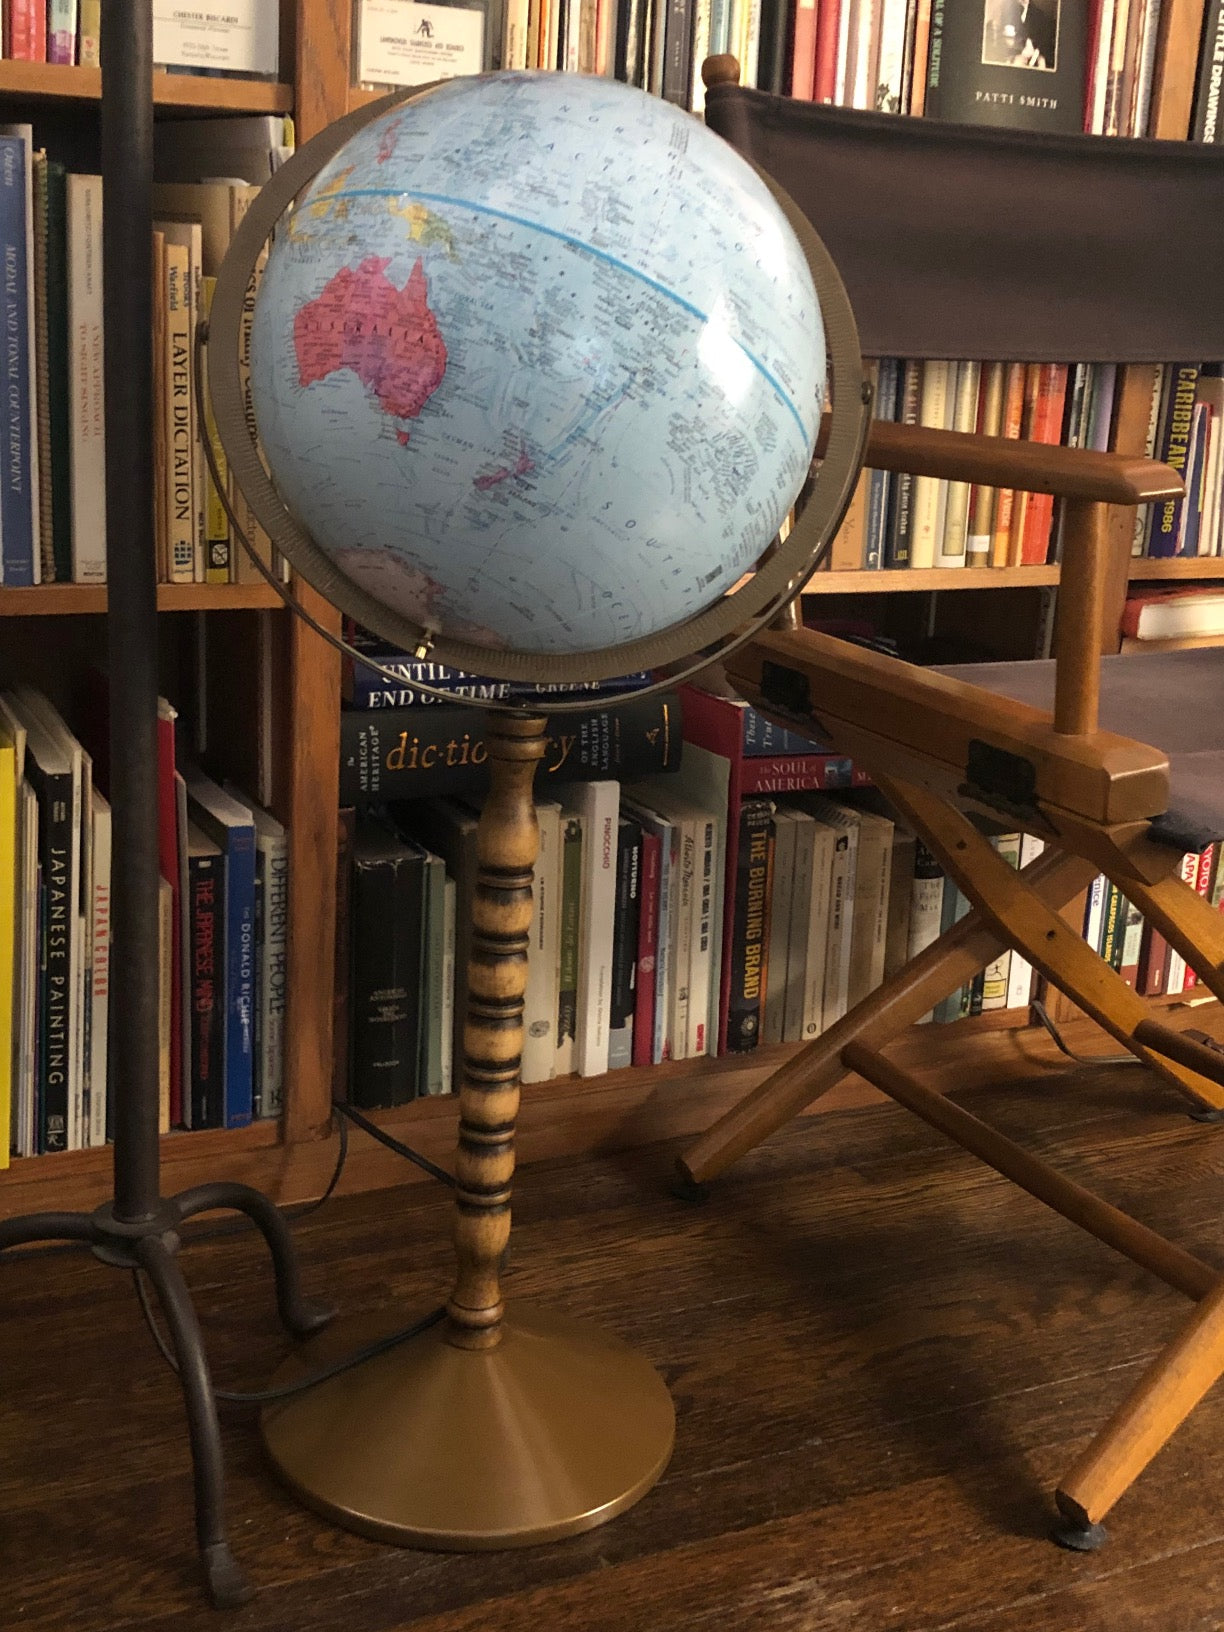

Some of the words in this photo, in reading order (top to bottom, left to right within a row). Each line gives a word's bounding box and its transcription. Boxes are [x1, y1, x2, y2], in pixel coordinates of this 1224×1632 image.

[929, 38, 942, 88] SOLITUDE
[975, 90, 1014, 105] PATTI
[1020, 95, 1058, 110] SMITH
[1202, 64, 1223, 144] DRAWINGS
[3, 146, 15, 187] Owen
[5, 244, 17, 295] MODAL
[168, 266, 179, 312] Warfield
[7, 299, 19, 332] AND
[8, 335, 20, 381] TONAL
[173, 332, 189, 397] LAYER
[9, 384, 22, 493] COUNTERPOINT
[1167, 367, 1198, 469] CARIBBEAN
[173, 405, 191, 521] DICTATION
[1160, 500, 1176, 534] 1986
[368, 689, 415, 709] END
[453, 683, 512, 702] TIME
[381, 662, 450, 685] UNTIL
[358, 731, 369, 793] AMERICAN
[590, 717, 599, 768] ENGLISH
[600, 712, 610, 771] LANGUAGE
[755, 776, 820, 793] AMERICA
[771, 760, 809, 777] SOUL
[601, 816, 613, 870] PINOCCHIO
[751, 829, 768, 862] THE
[196, 879, 213, 908] THE
[629, 846, 639, 899] NOTTURNO
[50, 847, 67, 960] JAPANESE
[95, 884, 109, 939] JAPAN
[270, 856, 288, 947] DIFFERENT
[745, 866, 765, 940] BURNING
[194, 911, 213, 978] JAPANESE
[240, 922, 252, 979] DONALD
[93, 945, 108, 998] COLOR
[269, 952, 287, 1016] PEOPLE
[743, 943, 762, 1000] BRAND
[48, 975, 65, 1086] PAINTING
